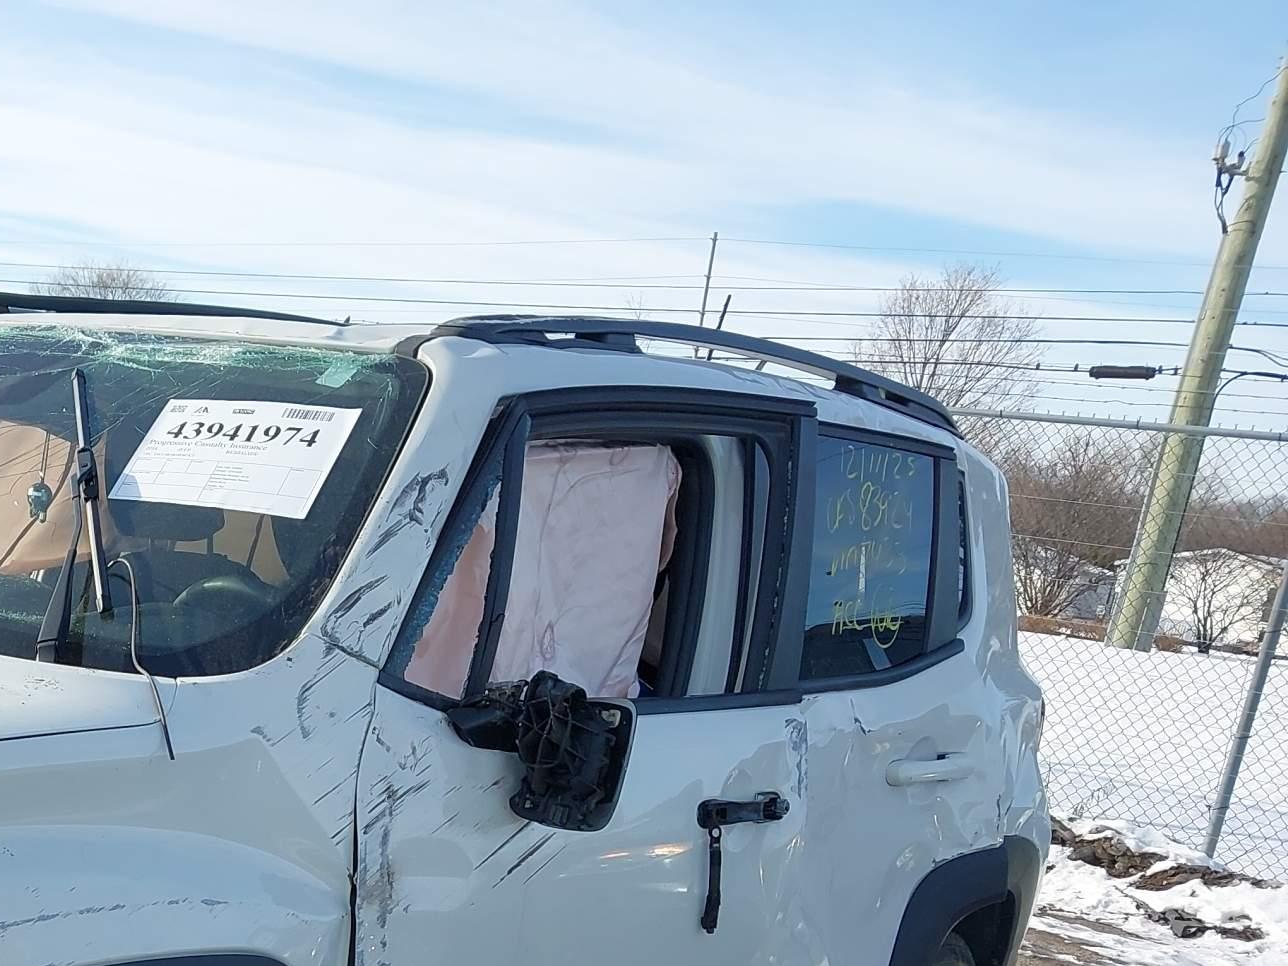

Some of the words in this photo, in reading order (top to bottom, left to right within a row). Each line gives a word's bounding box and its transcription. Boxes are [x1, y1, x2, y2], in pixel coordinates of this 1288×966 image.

[166, 420, 321, 448] 43941974
[149, 439, 193, 448] Progressive
[194, 440, 227, 449] Casualty
[229, 442, 268, 451] Insurance
